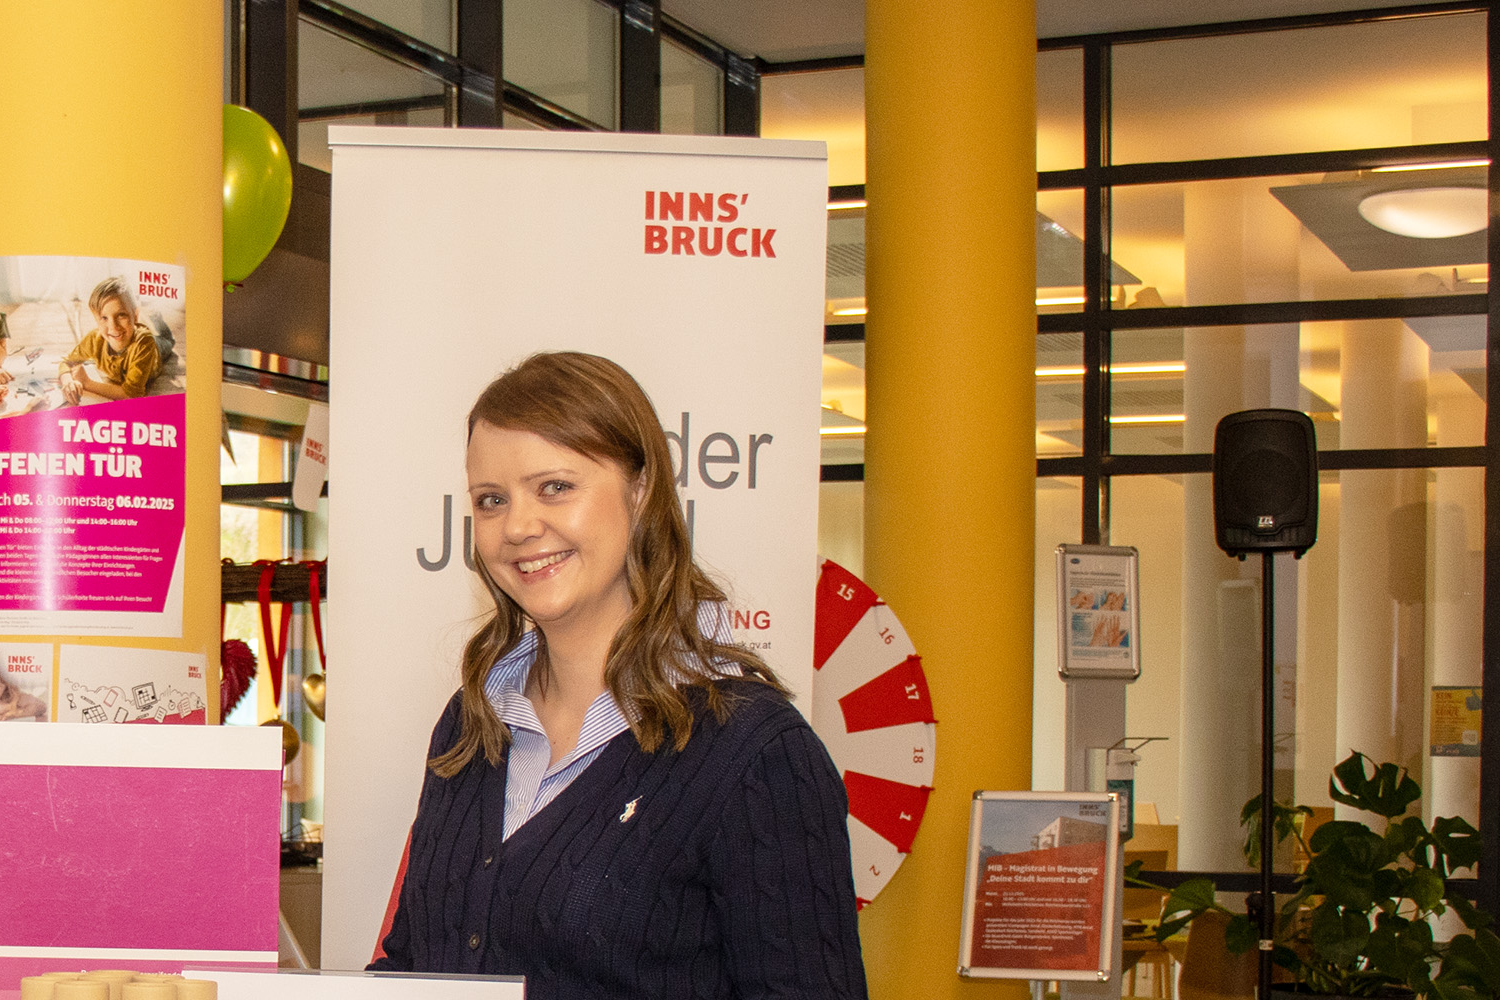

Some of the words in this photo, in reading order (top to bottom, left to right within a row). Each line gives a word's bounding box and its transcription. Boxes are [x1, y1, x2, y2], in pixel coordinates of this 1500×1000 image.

[644, 190, 749, 223] INNS'
[643, 225, 777, 258] BRUCK
[139, 270, 171, 285] INNS'
[138, 284, 178, 299] BRUCK
[58, 420, 127, 444] TAGE
[132, 422, 177, 448] DER
[90, 447, 142, 478] TÜR
[13, 494, 33, 506] 05.
[35, 494, 43, 506] &
[47, 494, 115, 511] Donnerstag
[116, 495, 175, 510] 06.02.2025
[836, 582, 856, 602] 15
[877, 626, 896, 646] 16
[8, 664, 42, 673] BRUCK
[904, 683, 920, 702] 17
[913, 747, 924, 764] 18
[899, 810, 912, 822] 1
[869, 865, 881, 878] 2
[987, 864, 1003, 872] MIB
[1009, 864, 1046, 874] Magistrat
[1047, 864, 1056, 872] in
[1057, 865, 1098, 876] Bewegung
[1014, 875, 1035, 883] Stadt
[1036, 875, 1065, 883] kommt
